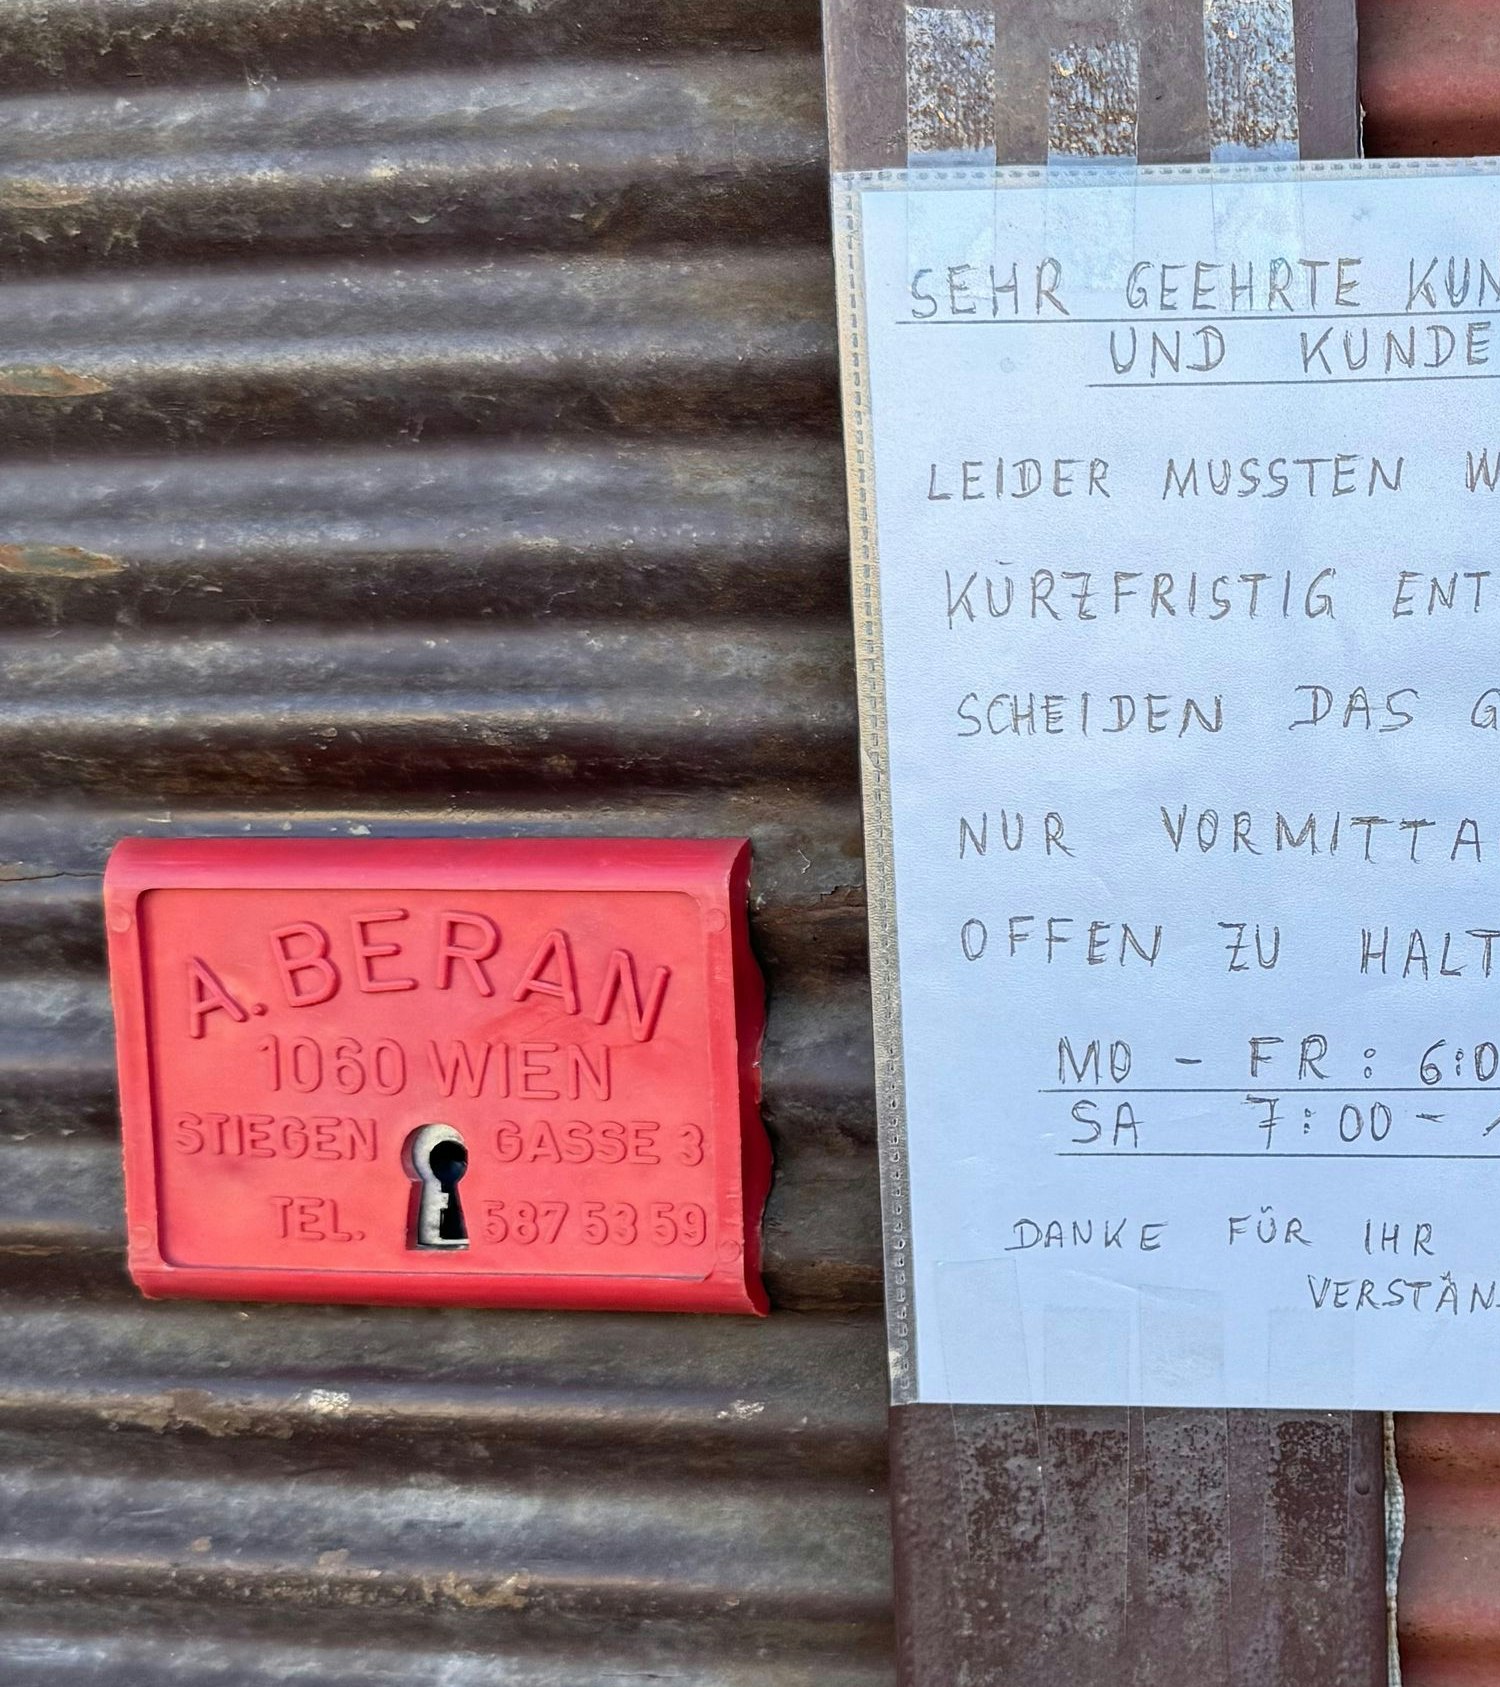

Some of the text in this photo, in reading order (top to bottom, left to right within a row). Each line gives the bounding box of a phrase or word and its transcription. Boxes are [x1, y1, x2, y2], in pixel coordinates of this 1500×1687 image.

[910, 257, 1071, 319] SEHR
[1126, 257, 1363, 313] GEEHRTE
[1109, 325, 1227, 375] UND
[927, 457, 1112, 501] LEIDER
[1162, 453, 1404, 500] MUSSTEN
[957, 692, 1223, 738] SCHEIDEN
[1288, 685, 1420, 733] DAS
[960, 810, 1076, 859] NUR
[961, 916, 1162, 967] OFFEN
[1217, 922, 1281, 972] ZU
[255, 1034, 612, 1102] 1060 WIEN
[1057, 1035, 1132, 1085] MO
[173, 1112, 705, 1168] STIEGEN GASSE 3
[1071, 1099, 1144, 1149] SA
[268, 1195, 707, 1247] TEL. 587 53 59
[1004, 1206, 1436, 1257] DANKE FÜR IHR
